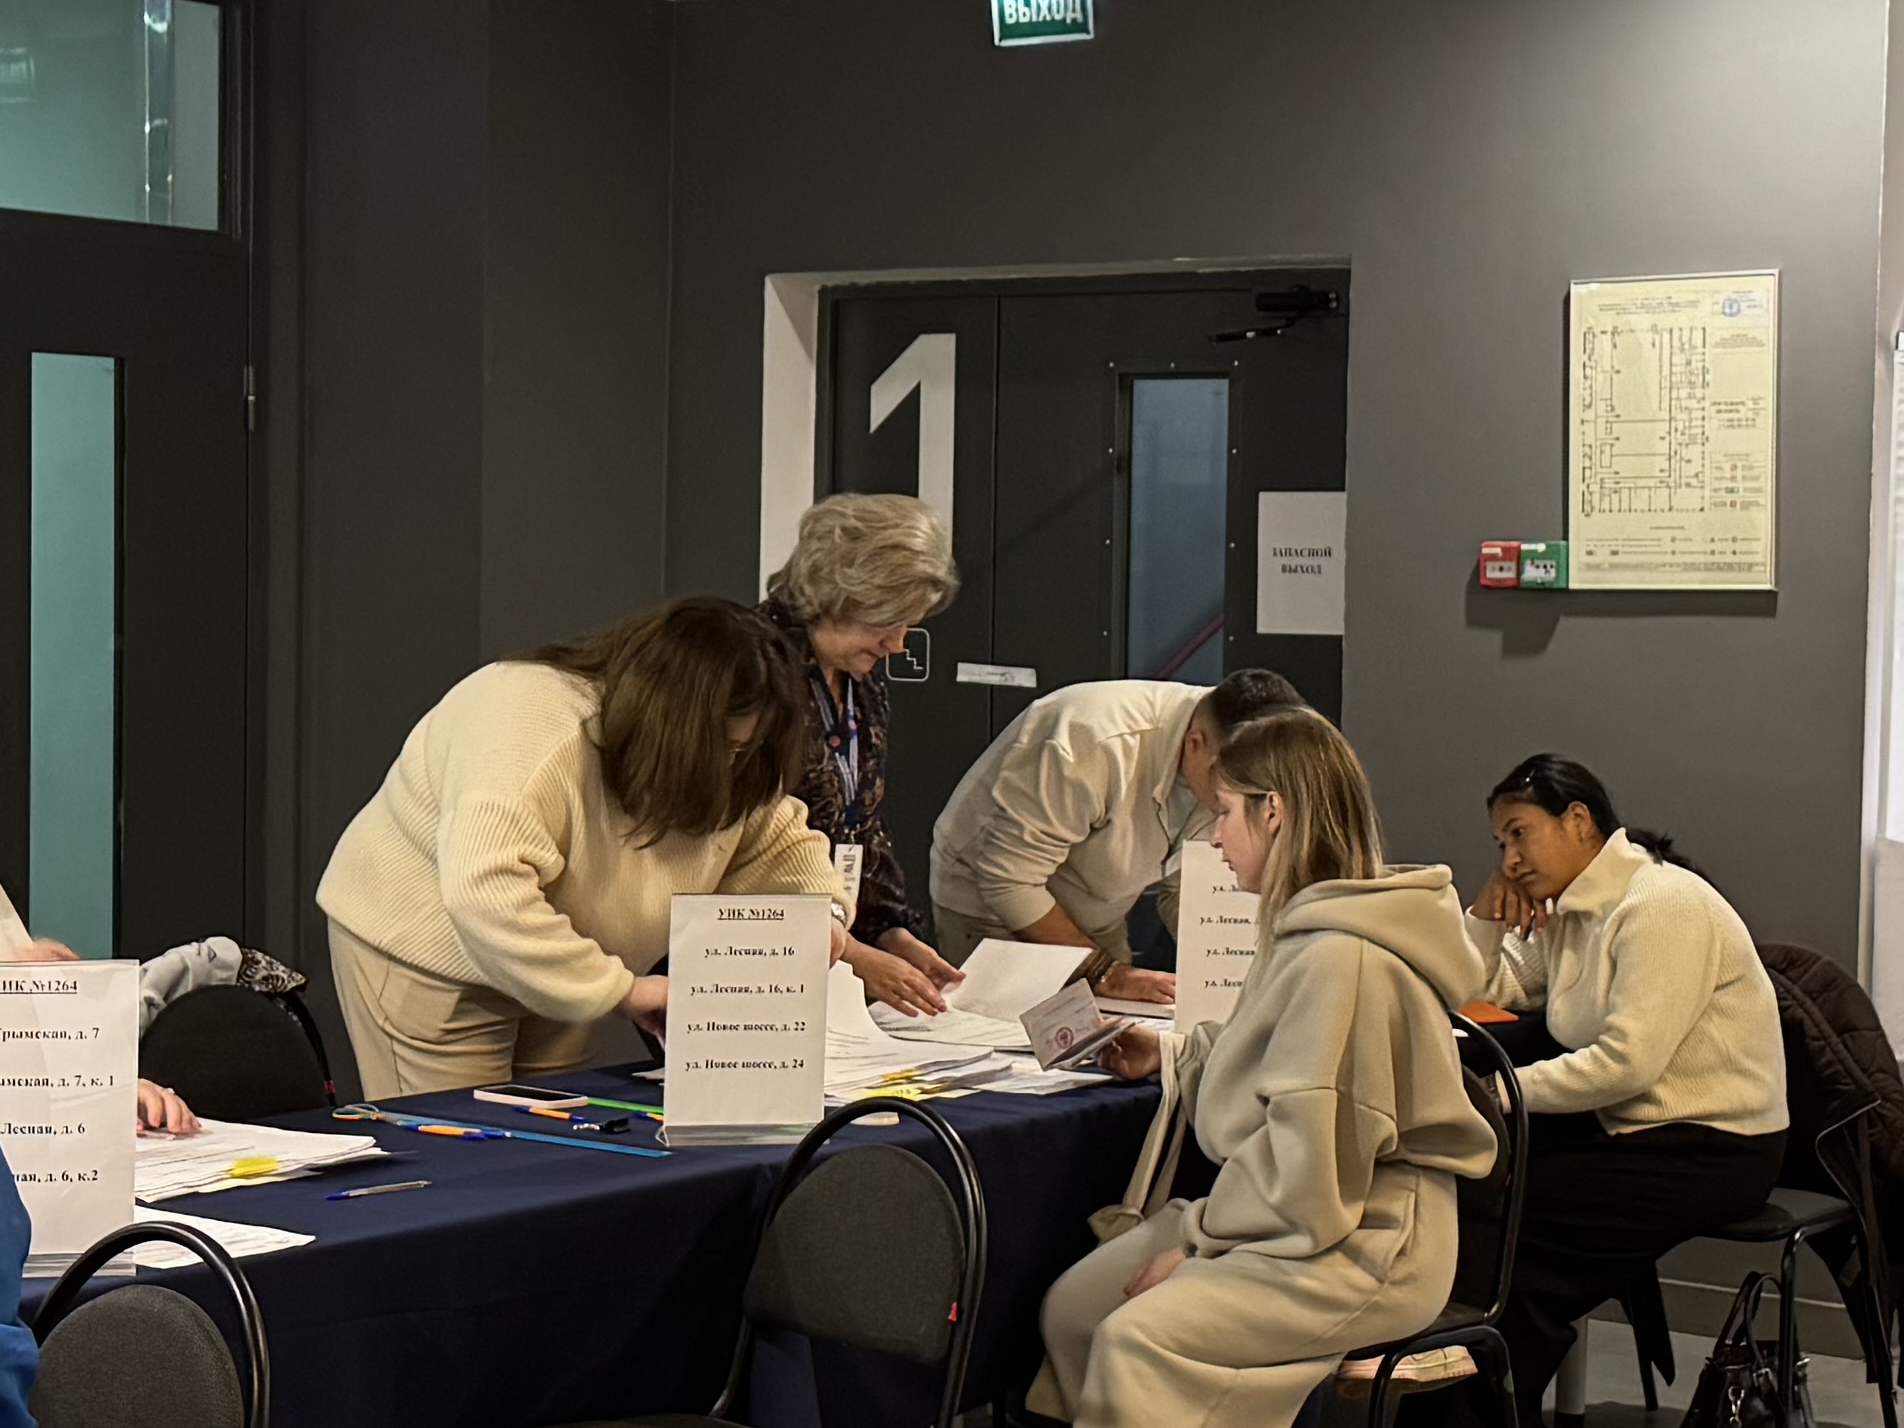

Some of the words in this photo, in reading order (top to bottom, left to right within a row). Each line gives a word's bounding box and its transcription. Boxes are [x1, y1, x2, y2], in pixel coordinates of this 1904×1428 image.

[870, 332, 957, 556] 1
[1272, 546, 1332, 557] ЗАПАСНОЙ
[1281, 564, 1322, 575] ВЫХОД
[718, 908, 744, 918] УИК
[748, 908, 785, 919] №1264
[704, 948, 722, 959] ул.
[724, 945, 767, 957] Лесная,
[783, 946, 795, 956] 16
[29, 980, 78, 992] №1264
[690, 986, 708, 997] ул.
[769, 984, 783, 994] 16,
[800, 983, 804, 994] 1
[706, 1021, 740, 1032] Новое
[743, 1023, 779, 1032] шоссе,
[794, 1021, 806, 1032] 22
[74, 1030, 88, 1040] д.
[92, 1027, 100, 1039] 7
[705, 1059, 738, 1069] Новое
[741, 1061, 778, 1070] шоссе,
[792, 1058, 804, 1069] 24
[57, 1078, 70, 1087] д.
[90, 1077, 104, 1087] к.
[109, 1075, 114, 1087] 1
[0, 1122, 57, 1136] Лесная,
[60, 1125, 73, 1135] д.
[77, 1123, 86, 1134] 6
[45, 1173, 57, 1183] д.
[77, 1169, 98, 1182] к.2
